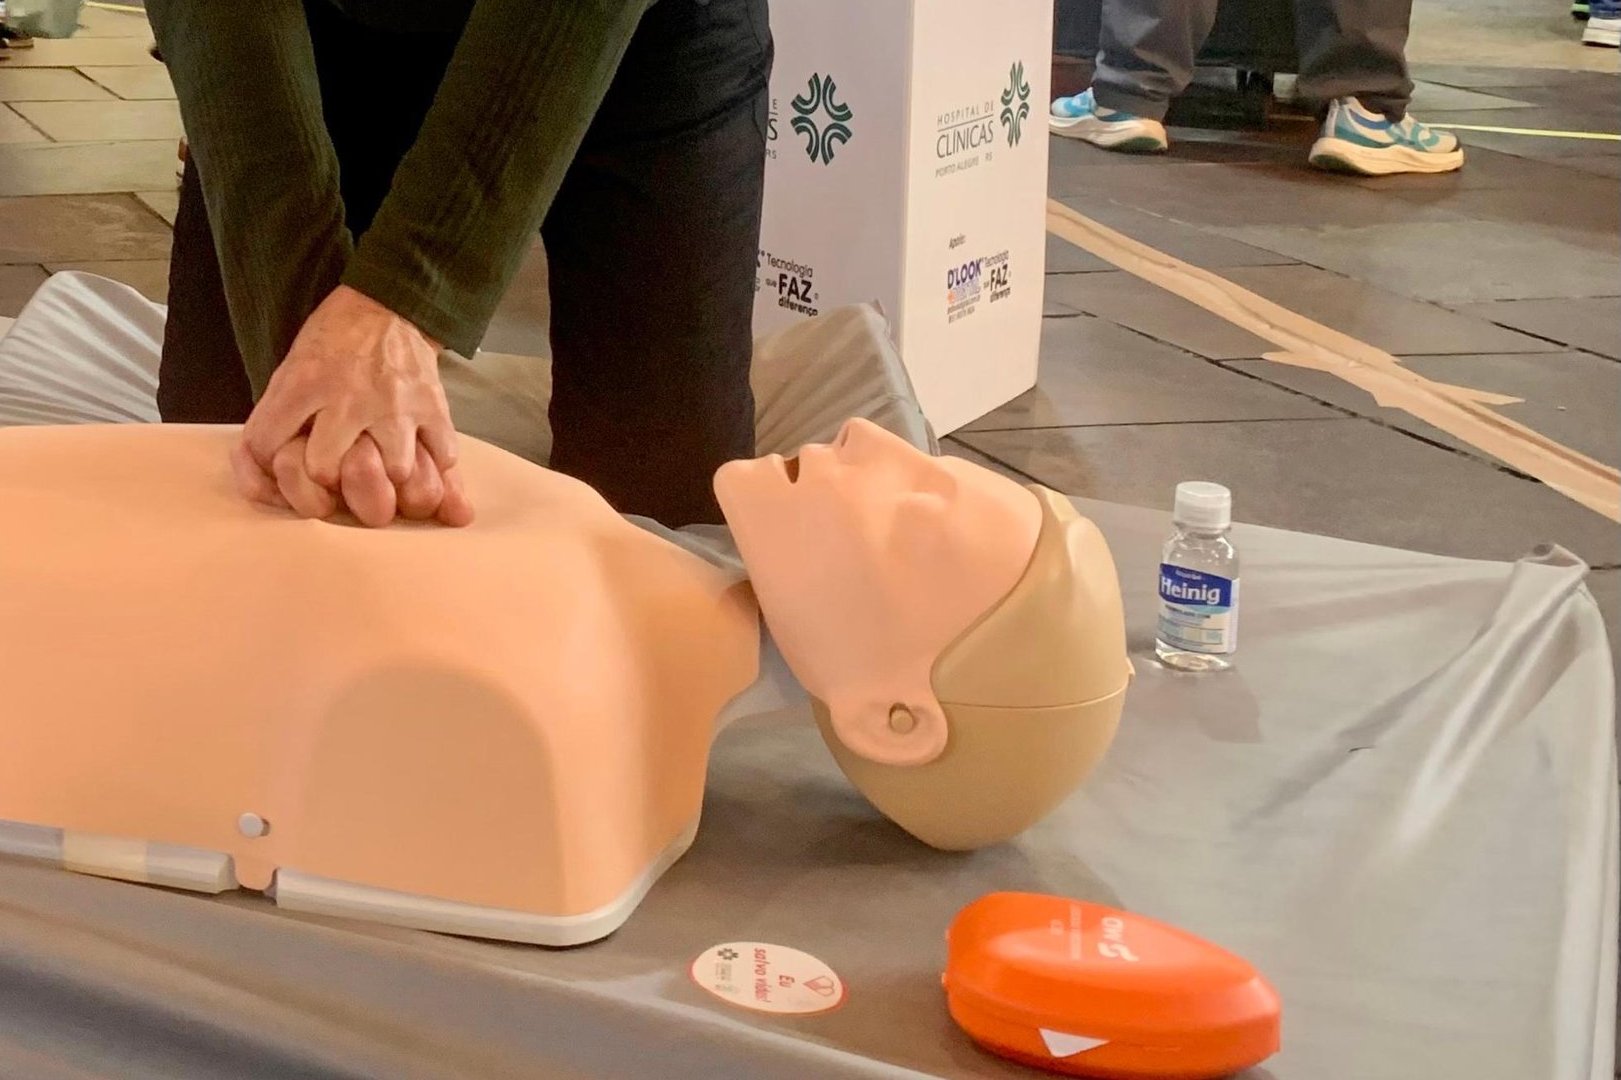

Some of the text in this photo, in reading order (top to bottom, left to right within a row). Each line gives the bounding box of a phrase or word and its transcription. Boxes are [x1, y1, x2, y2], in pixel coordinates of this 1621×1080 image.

[936, 103, 980, 127] HOSPITAL
[936, 119, 994, 159] CLÍNICAS
[767, 252, 813, 279] Tecnologia
[990, 263, 1008, 292] FAZ
[778, 273, 812, 304] FAZ
[1161, 575, 1222, 606] Heinig
[754, 947, 771, 976] salvo
[778, 974, 797, 989] Eu
